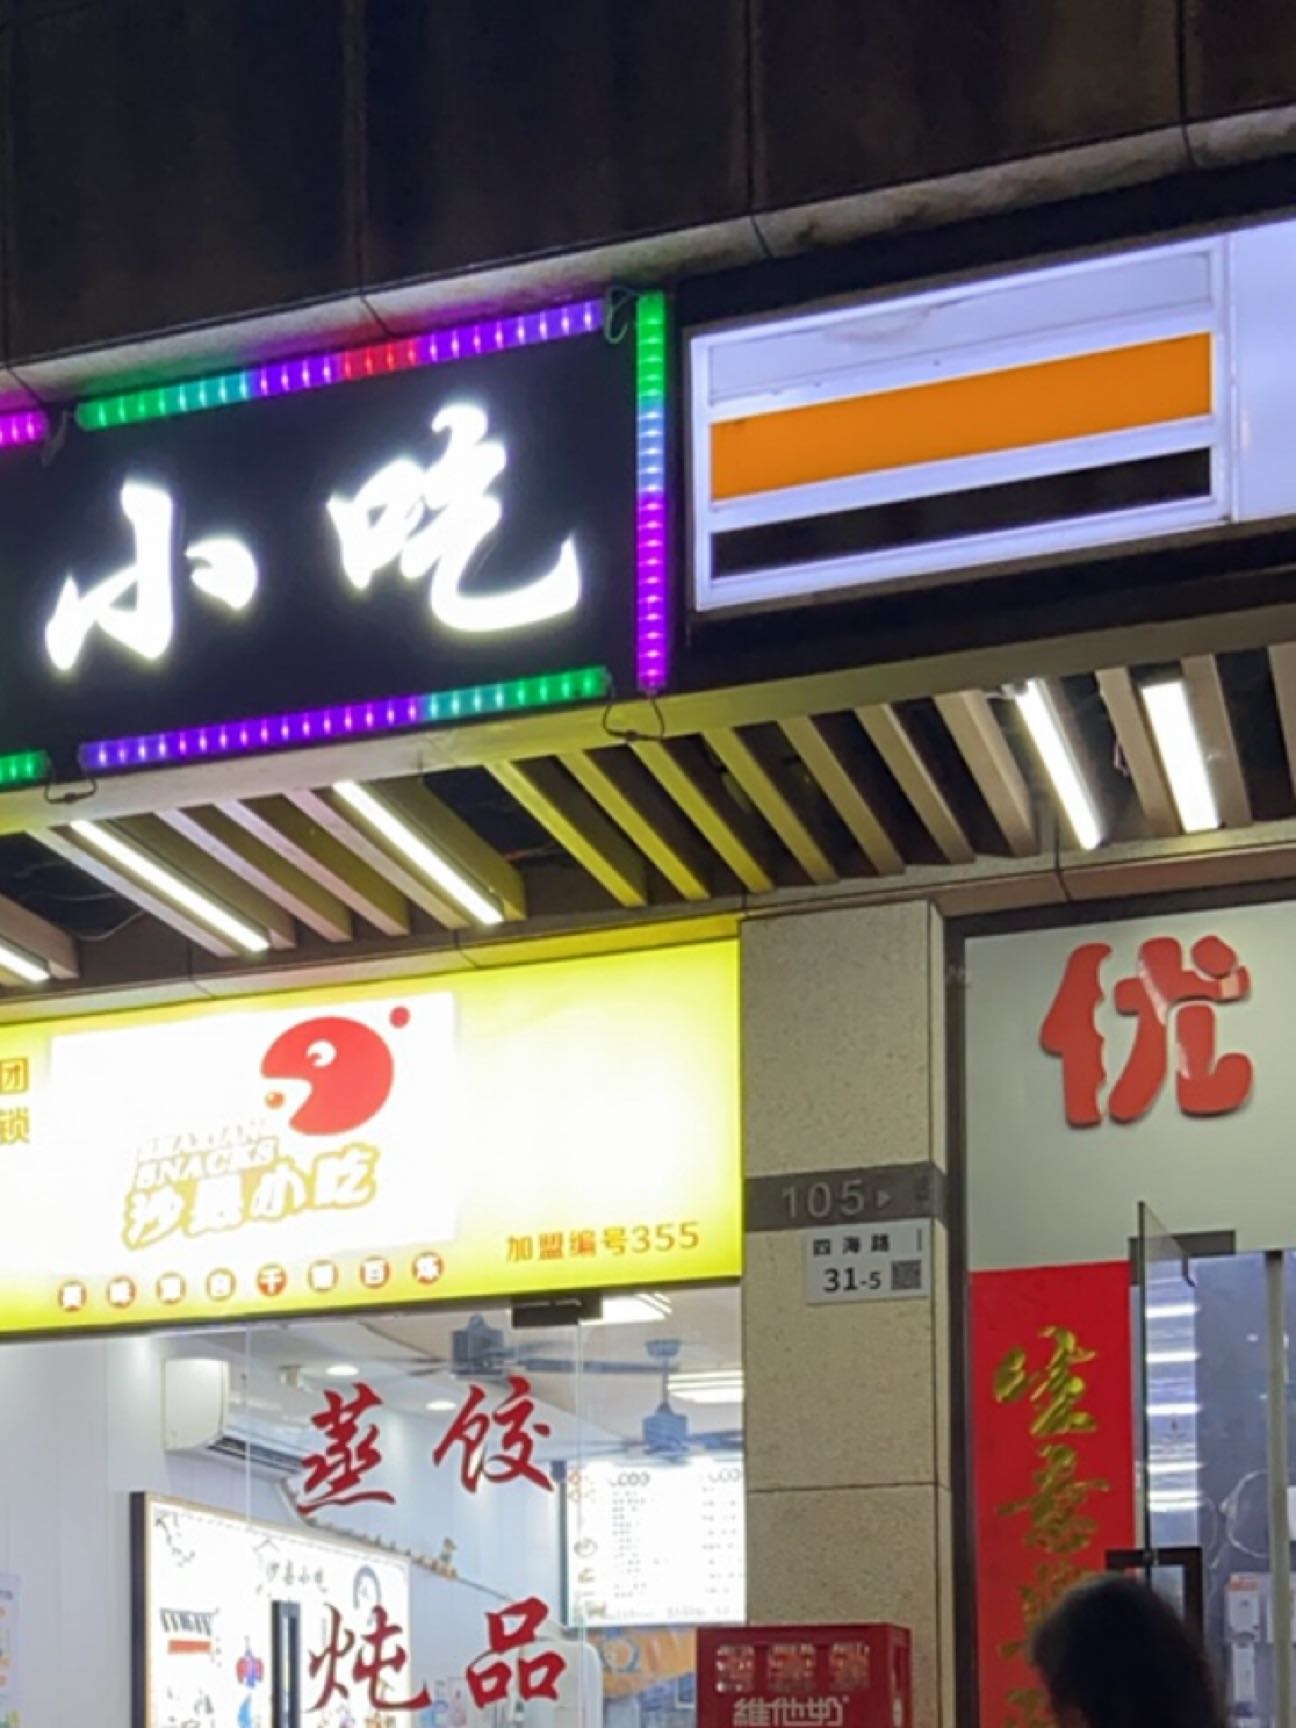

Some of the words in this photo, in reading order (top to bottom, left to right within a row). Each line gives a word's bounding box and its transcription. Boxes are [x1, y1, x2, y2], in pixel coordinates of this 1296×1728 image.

[1040, 935, 1254, 1128] 优
[782, 1180, 866, 1219] 105
[506, 1220, 699, 1263] 加盟编号355
[823, 1267, 882, 1293] 31-5
[298, 1375, 555, 1515] 蒸饺
[308, 1594, 568, 1713] 炖品
[733, 1697, 844, 1728] 維他奶
